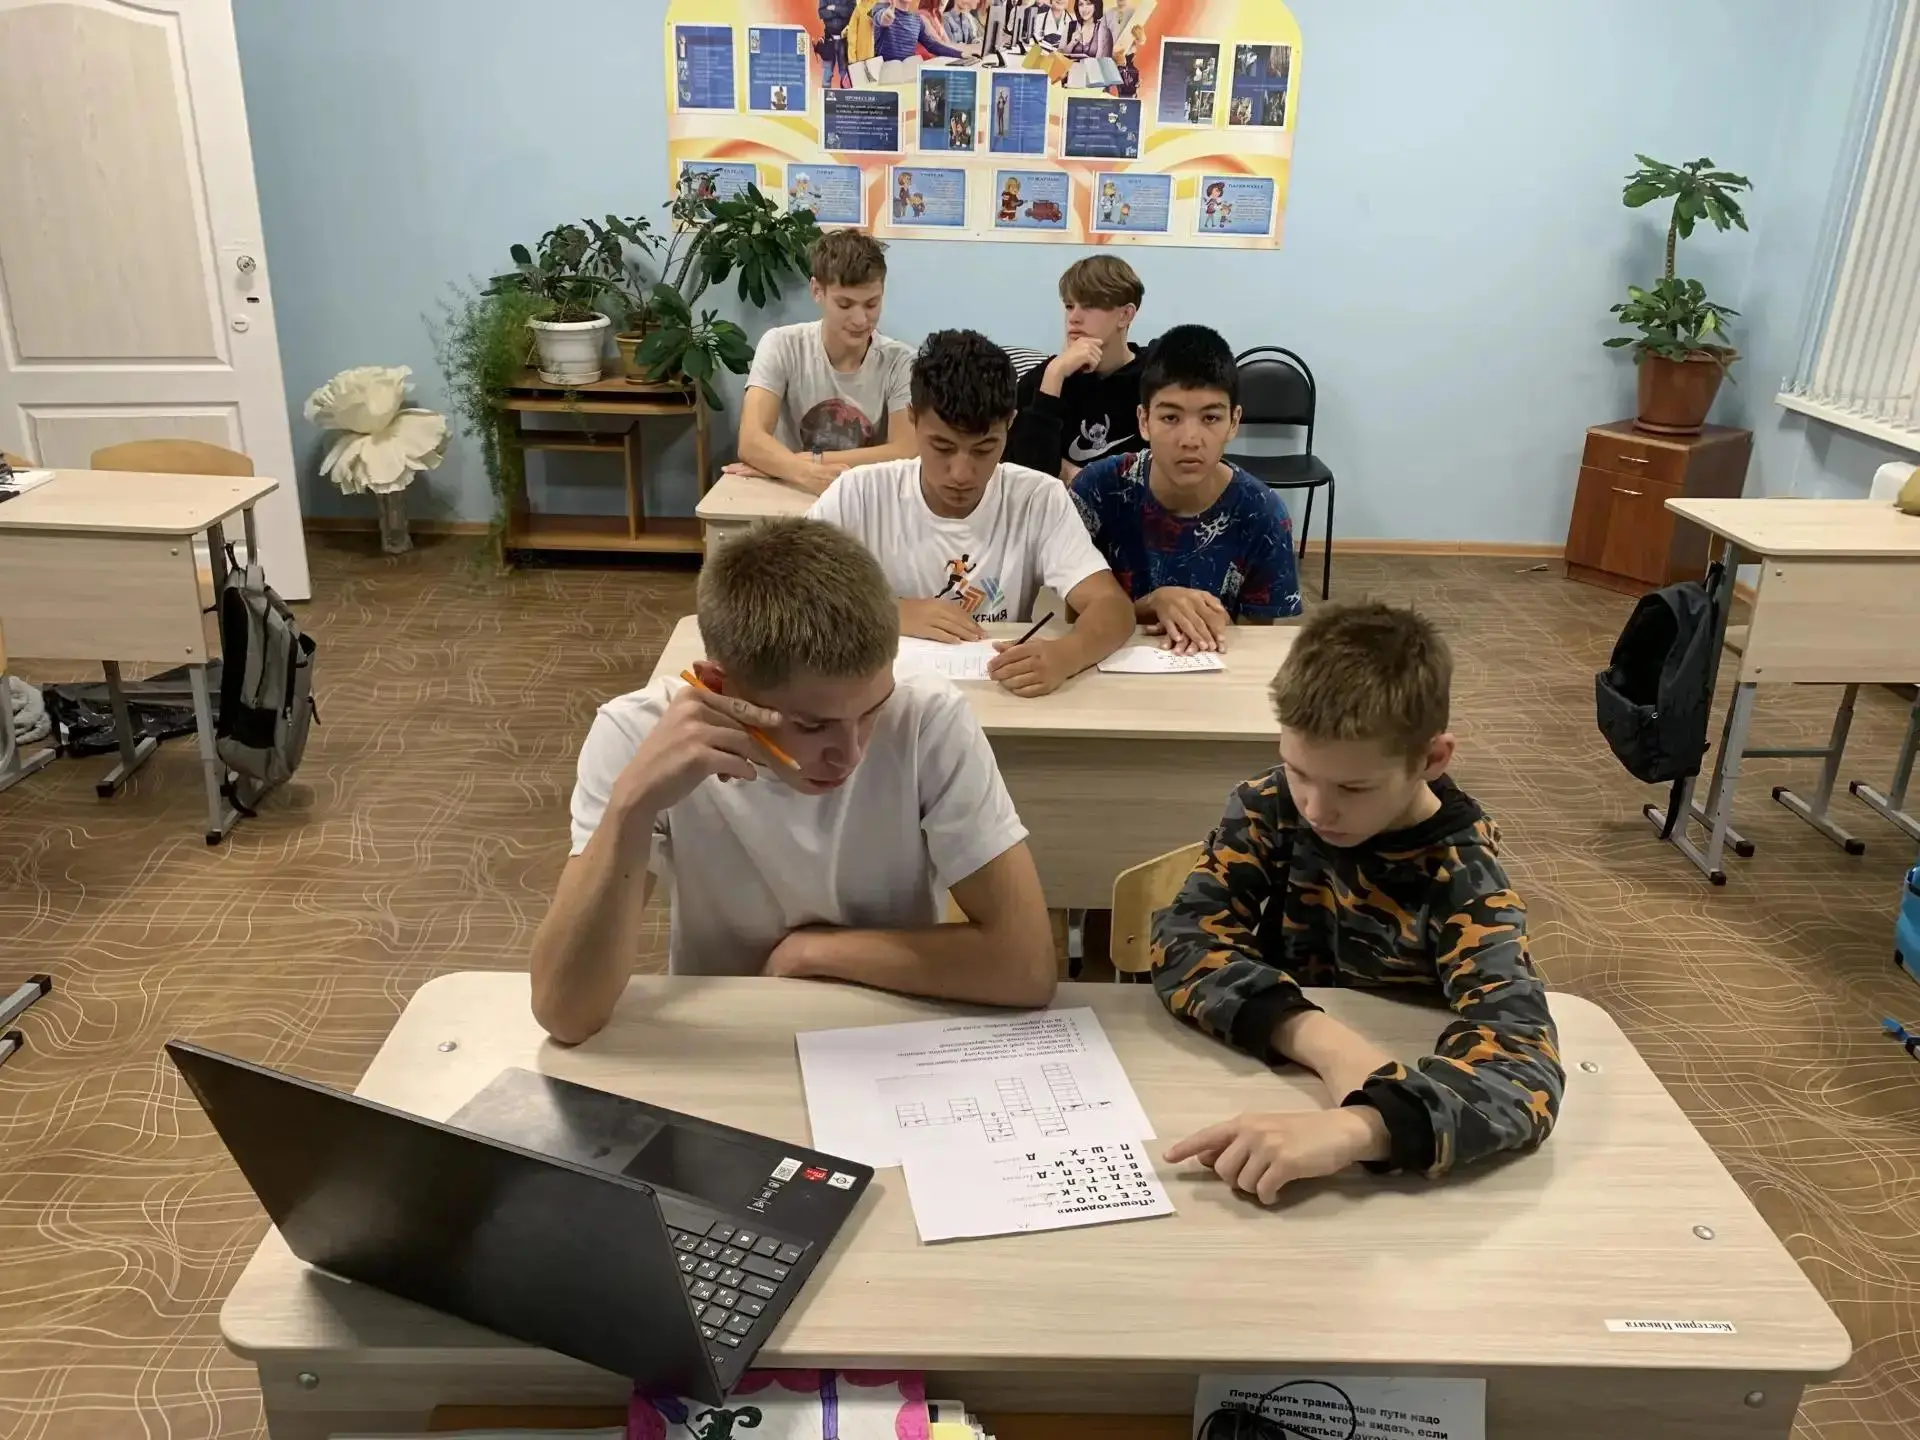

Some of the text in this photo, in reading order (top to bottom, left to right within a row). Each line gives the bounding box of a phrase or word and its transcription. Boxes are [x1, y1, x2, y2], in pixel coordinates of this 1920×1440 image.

[1625, 1321, 1673, 1331] Никита
[1272, 1406, 1327, 1423] трамвая,
[1369, 1420, 1415, 1437] видеть,
[1416, 1427, 1449, 1440] если
[1379, 1408, 1408, 1421] пути
[1410, 1412, 1441, 1426] надо
